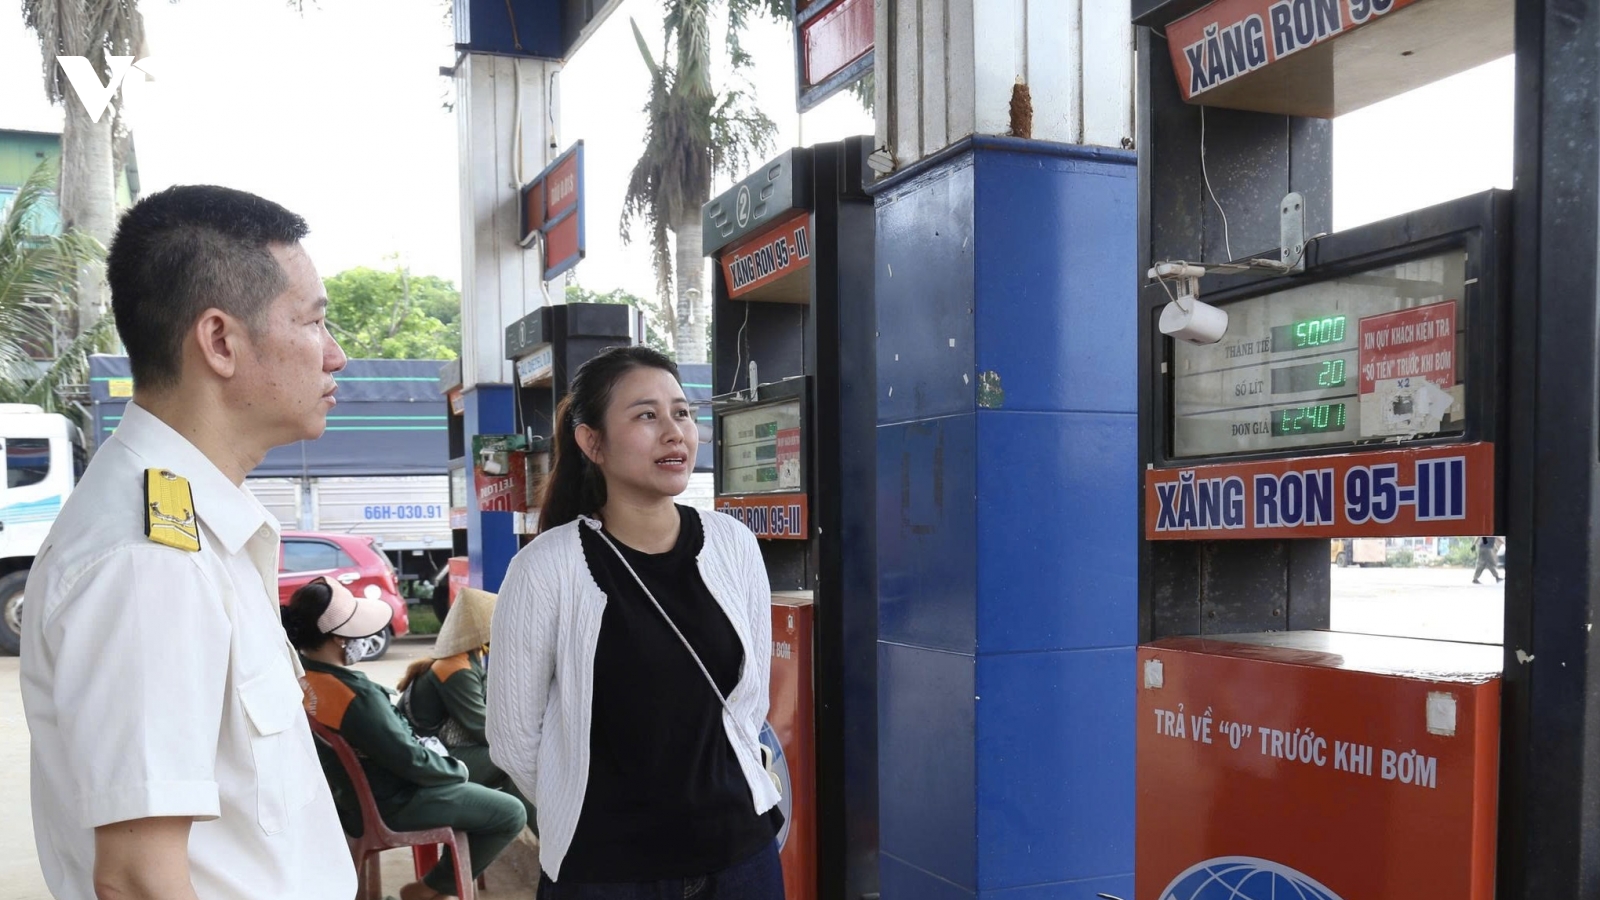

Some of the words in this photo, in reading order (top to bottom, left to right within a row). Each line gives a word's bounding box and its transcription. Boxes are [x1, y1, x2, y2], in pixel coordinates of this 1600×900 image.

[1183, 14, 1268, 98] XĂNG
[1268, 0, 1343, 61] RON
[740, 193, 747, 220] 2
[729, 255, 756, 291] XĂNG
[753, 243, 777, 280] RON
[1364, 332, 1375, 350] XIN
[1376, 324, 1389, 350] QUÝ
[1391, 321, 1414, 346] KHÁCH
[1436, 318, 1450, 338] TRA
[1397, 351, 1420, 377] TRƯỚC
[1421, 353, 1434, 373] KHI
[1435, 349, 1451, 371] BƠM
[1155, 470, 1245, 532] XĂNG
[1253, 468, 1335, 528] RON
[1344, 456, 1466, 524] 95-III
[364, 505, 442, 520] 66H-030.91
[746, 506, 768, 535] RON
[770, 505, 801, 535] 95-III
[1154, 703, 1186, 739] TRẢ
[1191, 706, 1213, 744] VỀ
[1258, 727, 1327, 767] TRƯỚC
[1334, 740, 1372, 776] KHI
[1381, 747, 1437, 789] BƠM
